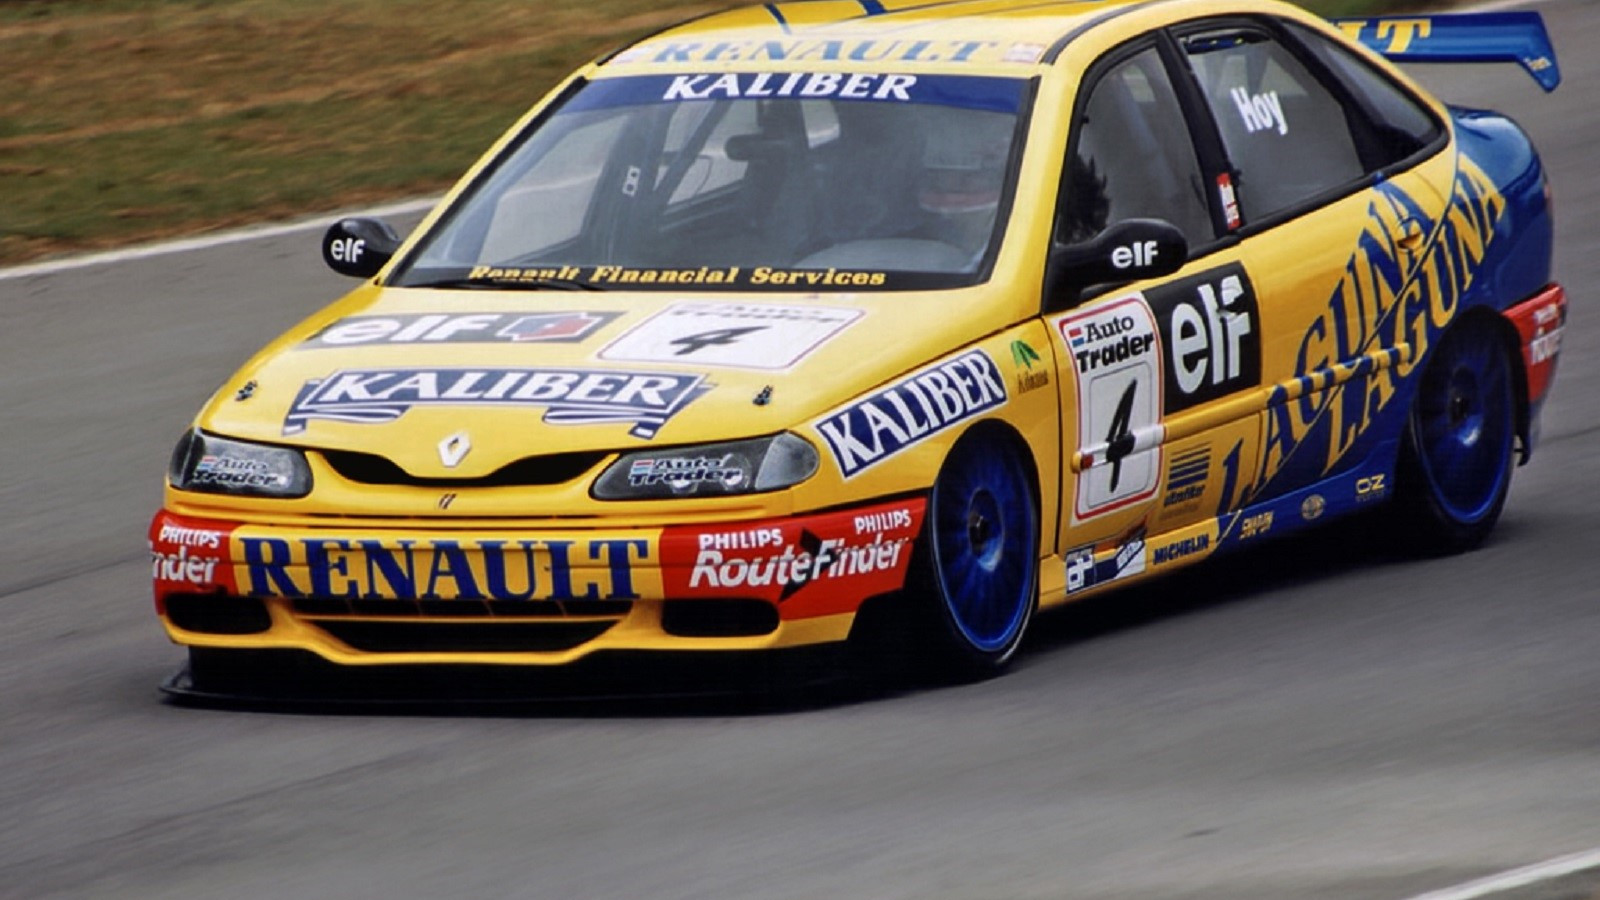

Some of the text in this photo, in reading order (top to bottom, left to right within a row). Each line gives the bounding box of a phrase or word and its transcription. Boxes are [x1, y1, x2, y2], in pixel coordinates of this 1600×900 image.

[653, 40, 997, 63] RENAULT
[662, 73, 918, 100] KALIBER
[1230, 86, 1289, 136] Hoy
[330, 238, 365, 263] elf
[1111, 241, 1159, 268] elf
[467, 265, 887, 286] Renault Financial Services
[1321, 151, 1506, 477] LAGUNA
[321, 314, 504, 344] elf
[669, 325, 772, 356] 4
[1084, 315, 1135, 344] Auto
[1171, 274, 1251, 394] elf
[1076, 331, 1154, 374] Trader
[1215, 172, 1436, 518] LAGUNA
[318, 371, 679, 406] KALIBER
[821, 352, 1004, 474] KALIBER
[1104, 375, 1139, 494] 4
[628, 468, 742, 486] Trader
[654, 457, 723, 470] Auto
[1356, 474, 1386, 494] OZ
[854, 509, 912, 535] PHILIPS
[159, 525, 220, 549] PHILIPS
[699, 529, 784, 551] PHILIPS
[1154, 533, 1210, 567] MICHELIN
[240, 537, 649, 600] RENAULT
